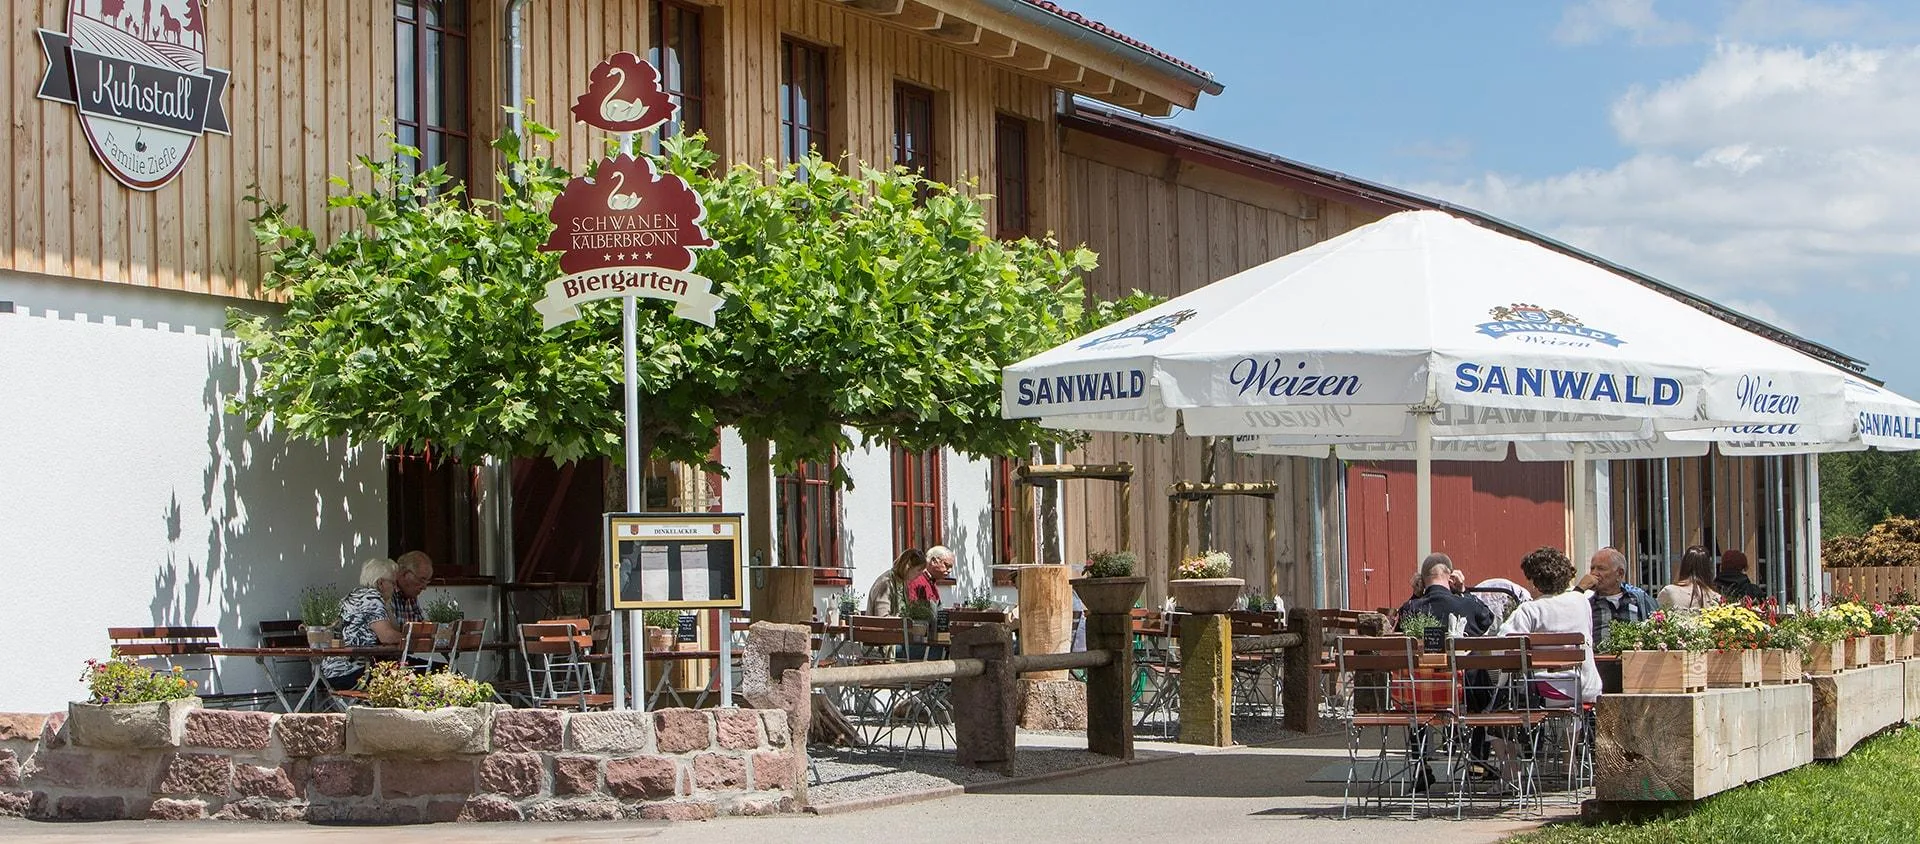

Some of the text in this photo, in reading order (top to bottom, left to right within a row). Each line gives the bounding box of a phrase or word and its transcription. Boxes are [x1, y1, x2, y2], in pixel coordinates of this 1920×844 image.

[92, 60, 194, 121] Kuhstall
[104, 131, 177, 175] Familie Ziefle
[572, 214, 677, 232] SCHWANEN
[572, 231, 677, 249] KÄLBERBRONN
[562, 270, 689, 299] Biergarten
[1487, 321, 1607, 340] SANWALD
[1516, 334, 1591, 348] Weizen
[1017, 369, 1147, 407] SANWALD
[1229, 358, 1363, 397] Weizen
[1455, 362, 1684, 406] SANWALD
[1736, 374, 1800, 415] Weizen
